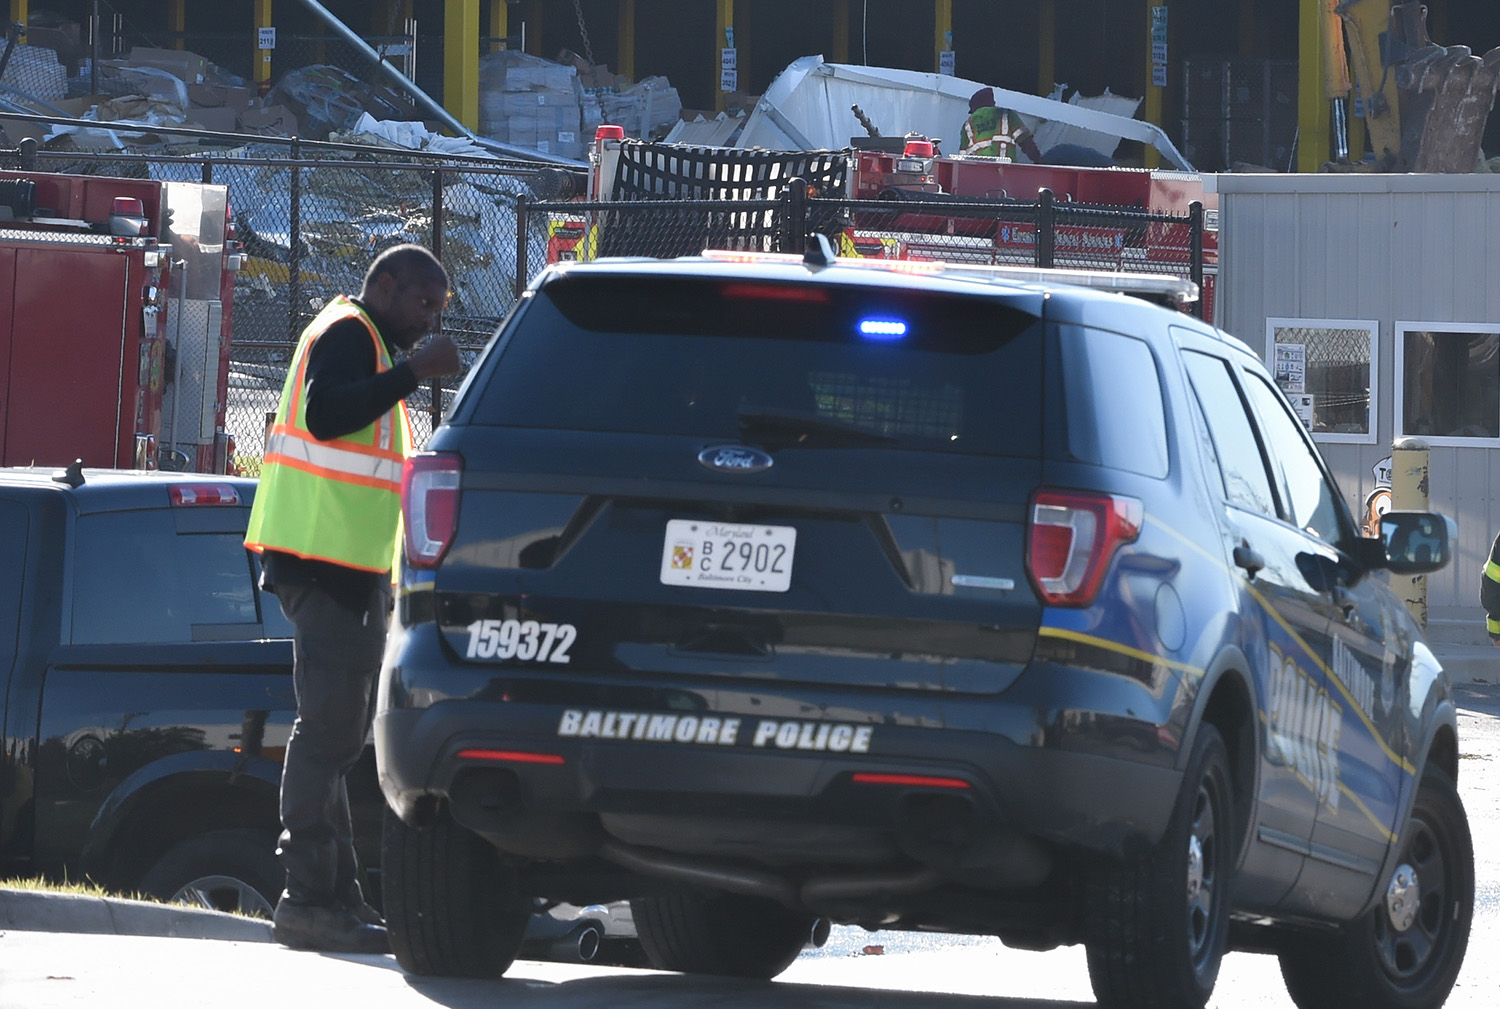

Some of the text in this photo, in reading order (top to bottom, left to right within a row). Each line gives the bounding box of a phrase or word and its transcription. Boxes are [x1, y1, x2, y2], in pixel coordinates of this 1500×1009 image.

[714, 449, 754, 468] Ford
[705, 526, 754, 539] Maryland
[720, 542, 786, 574] 2902
[697, 573, 752, 584] Baltimore City
[466, 619, 577, 664] 159372
[558, 709, 873, 753] BALTIMORE POLICE
